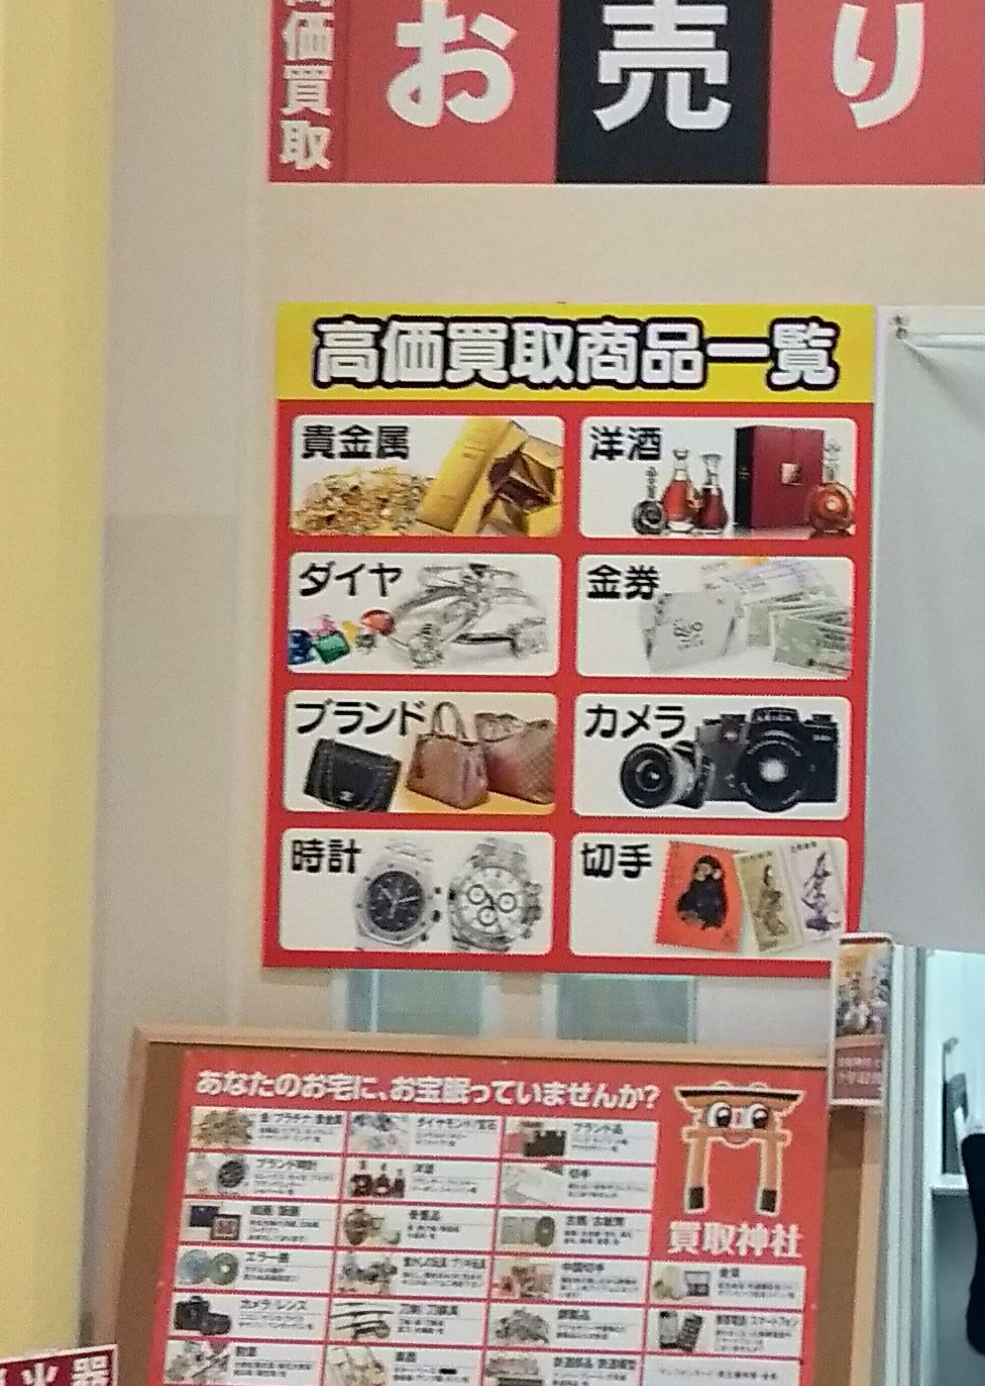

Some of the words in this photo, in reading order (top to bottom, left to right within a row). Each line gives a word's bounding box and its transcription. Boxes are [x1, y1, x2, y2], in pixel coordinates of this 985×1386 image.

[314, 317, 838, 389] 高価買取商品一覧
[301, 424, 410, 462] 貴金属
[588, 424, 662, 462] 洋酒
[298, 563, 403, 598] ダイヤ
[586, 565, 661, 601] 金券
[295, 700, 427, 736] ブランド
[583, 702, 688, 740] カメラ
[291, 839, 362, 875] 時計
[580, 841, 653, 879] 切手
[195, 1069, 661, 1110] あなたのお宅に、お宝眠っていませんか?
[667, 1220, 803, 1258] 買取神社
